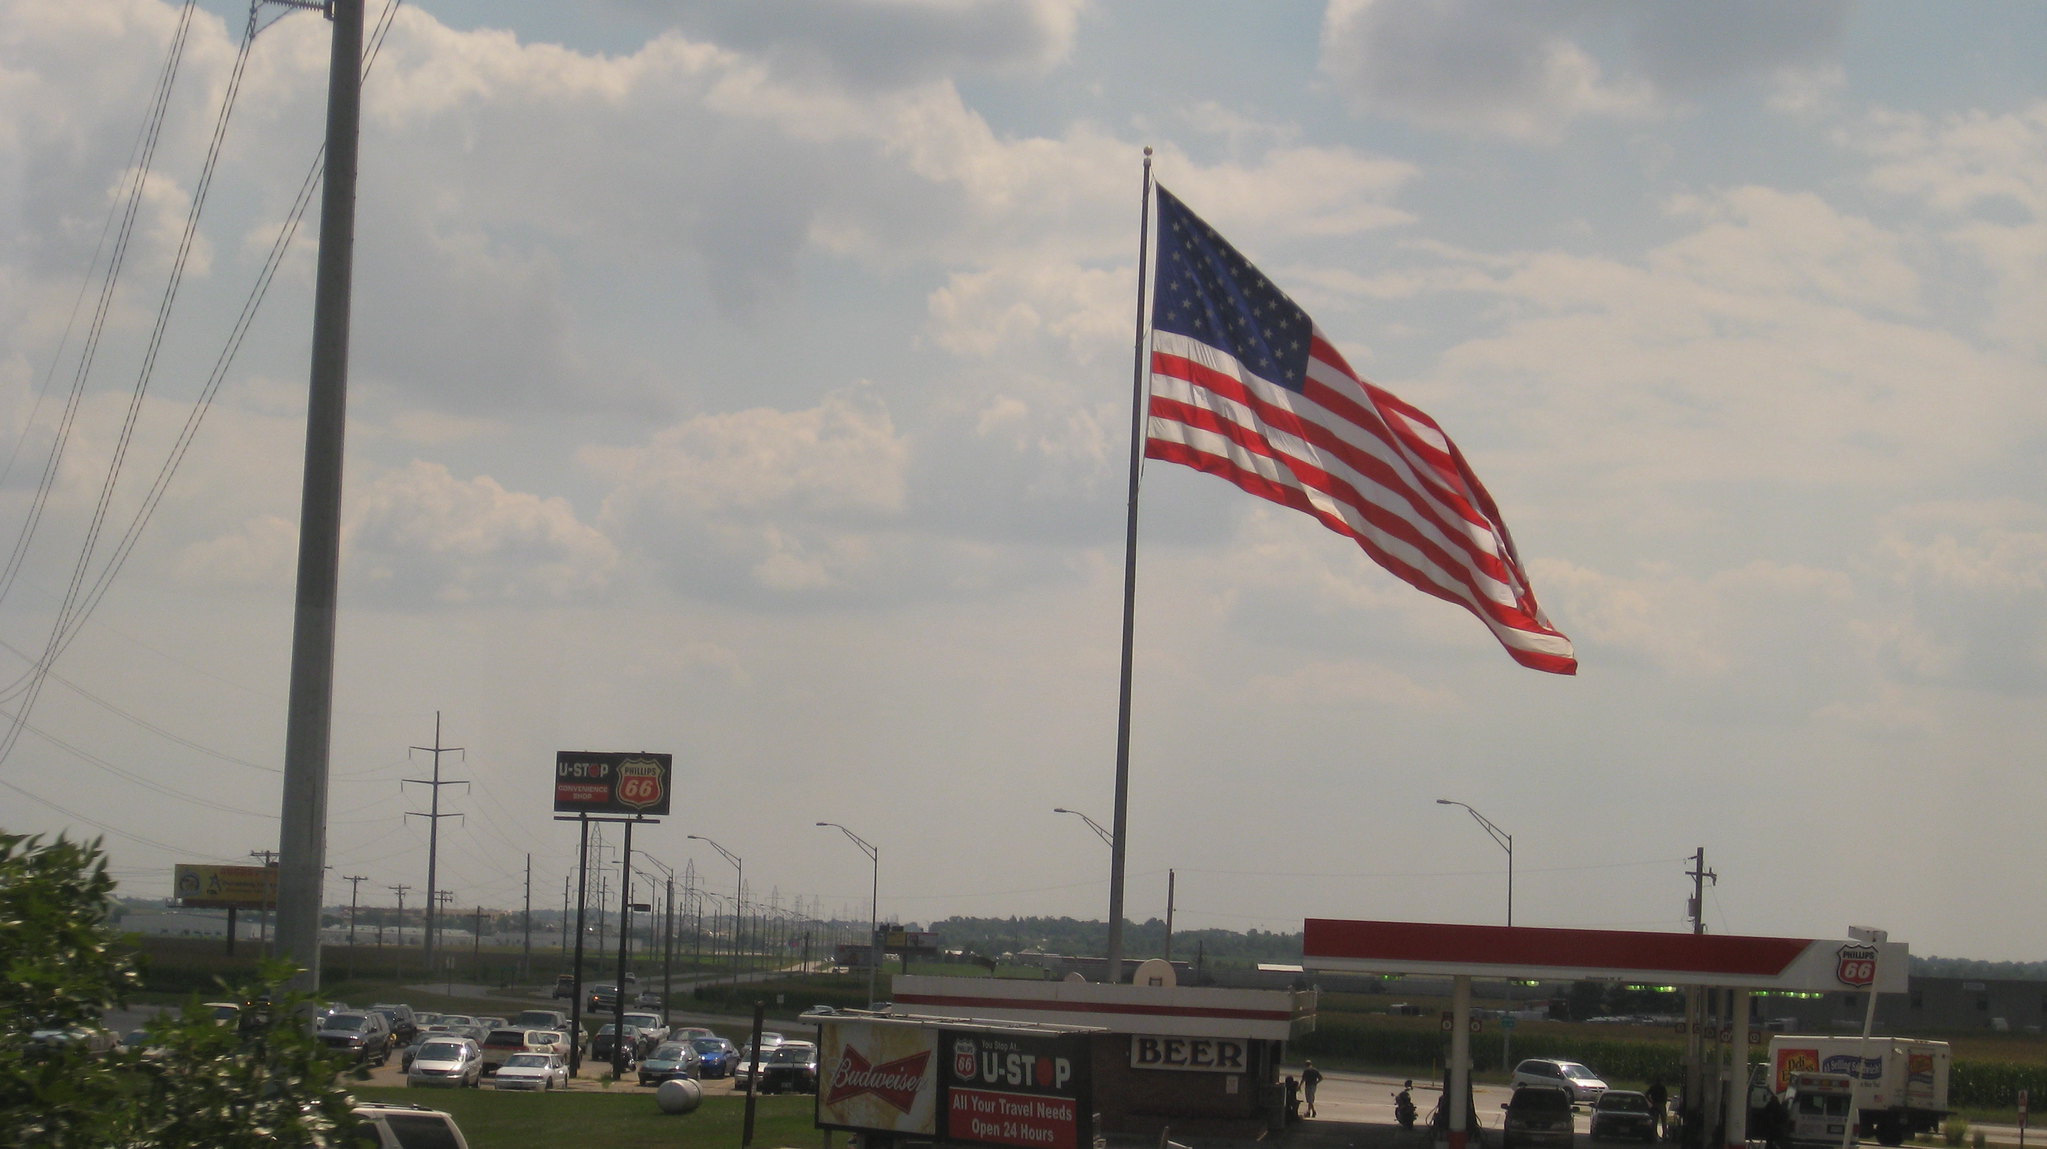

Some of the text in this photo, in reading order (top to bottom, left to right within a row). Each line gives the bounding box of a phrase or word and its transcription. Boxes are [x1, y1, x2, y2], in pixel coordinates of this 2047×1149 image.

[558, 762, 609, 777] U-STOP
[624, 767, 657, 776] PHILLIPS
[558, 784, 609, 793] CONVENIENCE
[625, 780, 655, 798] 66
[1842, 951, 1874, 959] PHILLIPS
[1844, 962, 1873, 979] 66
[994, 1040, 1009, 1052] Stop
[1136, 1038, 1243, 1068] BEER
[957, 1056, 973, 1072] 66
[982, 1051, 1071, 1089] U-STOP
[1787, 1055, 1805, 1071] Deli
[827, 1057, 928, 1092] Budweiser
[952, 1094, 1073, 1121] All Your Travel Needs
[971, 1117, 1054, 1142] Open 24 Hours
